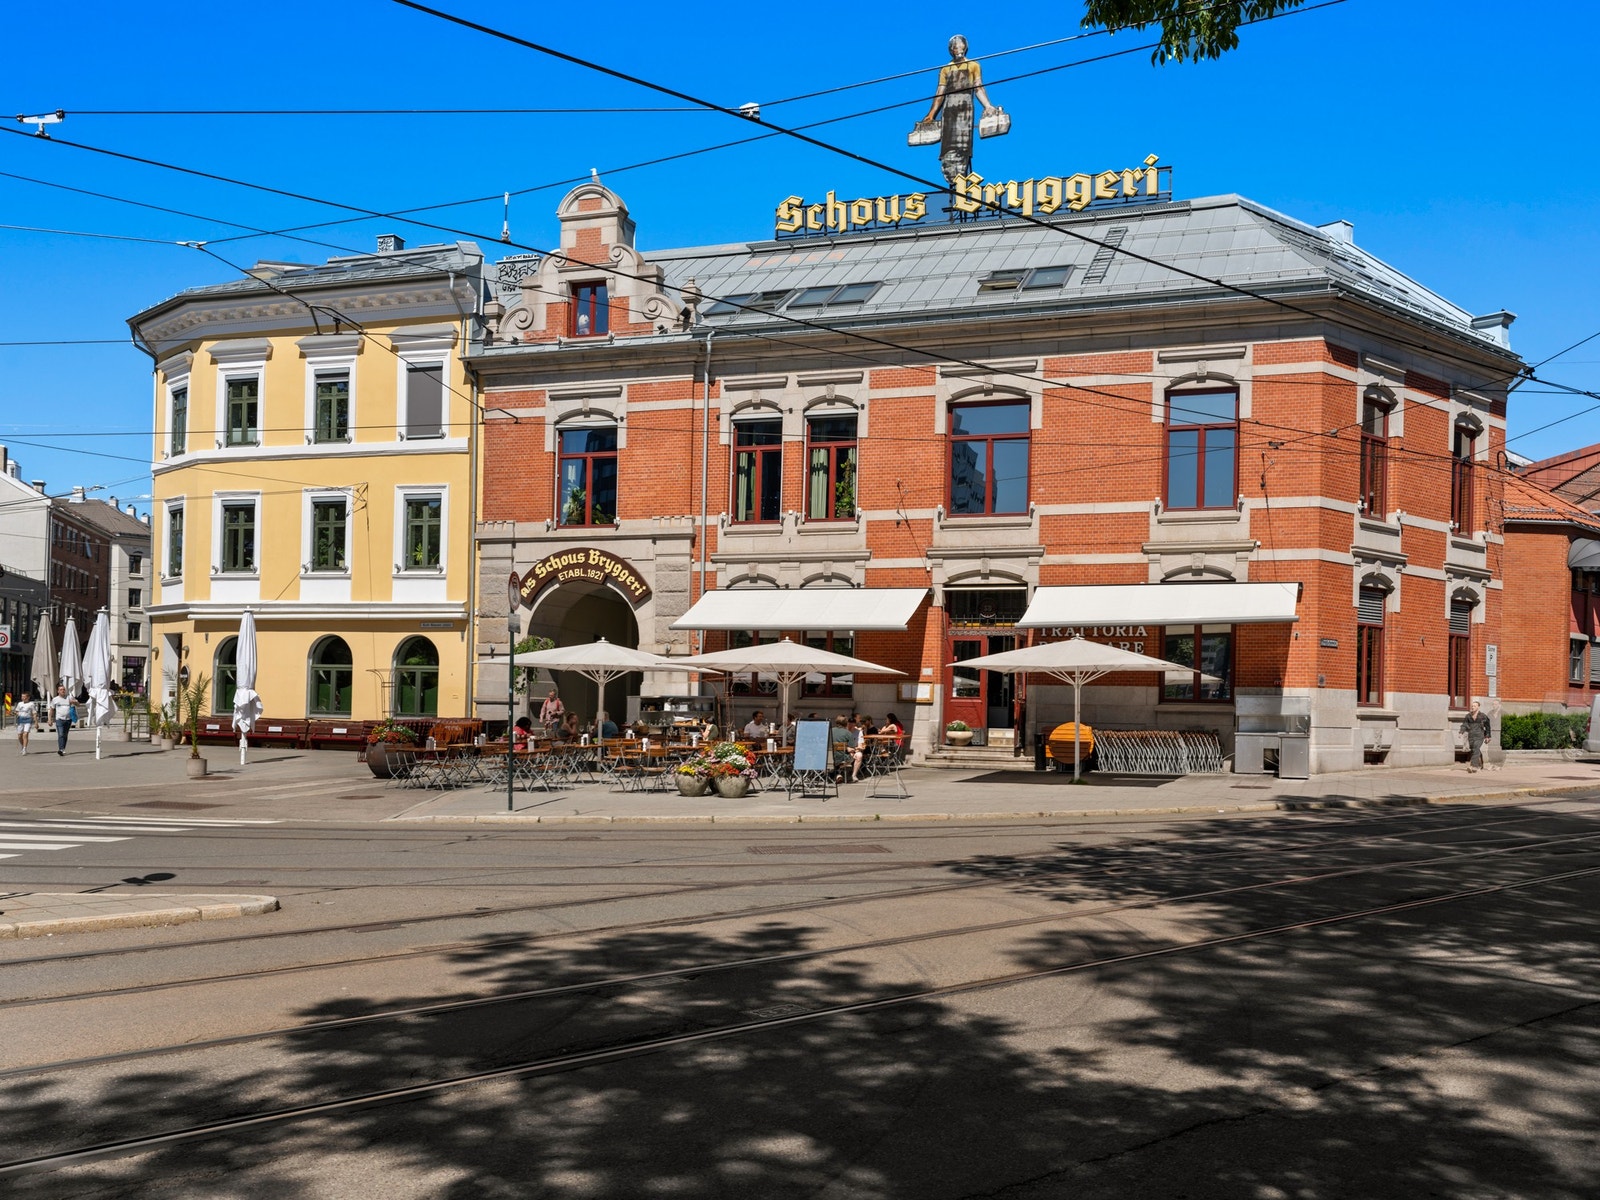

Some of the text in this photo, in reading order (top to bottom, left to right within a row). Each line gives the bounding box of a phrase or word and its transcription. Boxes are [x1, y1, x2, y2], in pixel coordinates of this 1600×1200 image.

[776, 154, 1159, 233] Schous Bryggeri
[535, 552, 586, 579] Schous
[588, 549, 647, 597] Bryggeri
[1040, 625, 1148, 637] TRATTORIA
